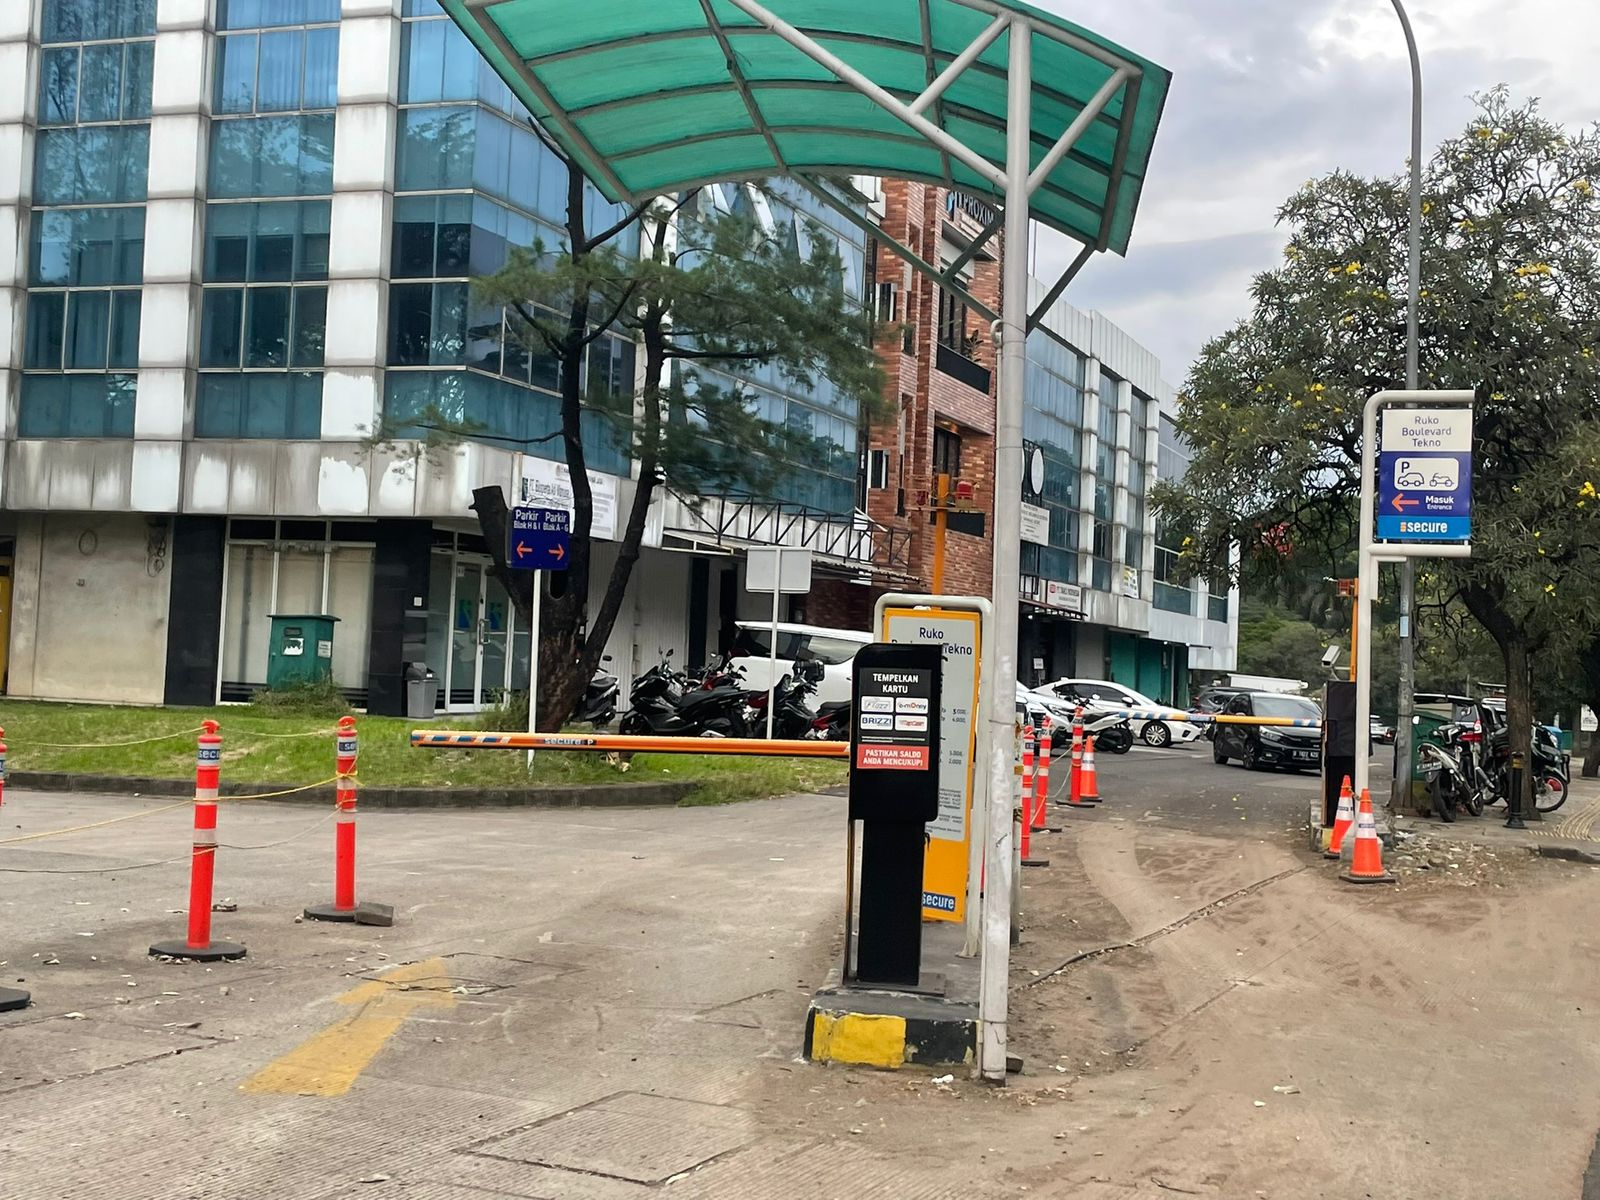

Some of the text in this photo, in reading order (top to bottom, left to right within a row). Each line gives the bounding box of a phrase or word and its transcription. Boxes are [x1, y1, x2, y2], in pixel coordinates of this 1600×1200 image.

[1414, 415, 1439, 425] Ruko
[1401, 426, 1452, 437] Boulevard
[1412, 438, 1441, 447] Tekno
[1401, 461, 1410, 473] P
[1425, 495, 1454, 504] Masuk
[515, 509, 539, 520] Parkir
[545, 511, 567, 523] Parkir
[513, 520, 526, 529] Blok
[527, 521, 532, 529] H
[533, 521, 537, 530] &
[543, 522, 555, 531] Blok
[556, 523, 561, 531] A
[564, 523, 569, 532] G
[1407, 521, 1448, 533] secure
[919, 626, 944, 640] Ruko
[872, 673, 919, 683] TEMPELKAN
[882, 684, 909, 693] KARTU
[862, 717, 892, 725] BRIZZI
[865, 749, 921, 758] PASTIKAN SALDO
[863, 757, 923, 766] ANDA MENCUKUPI
